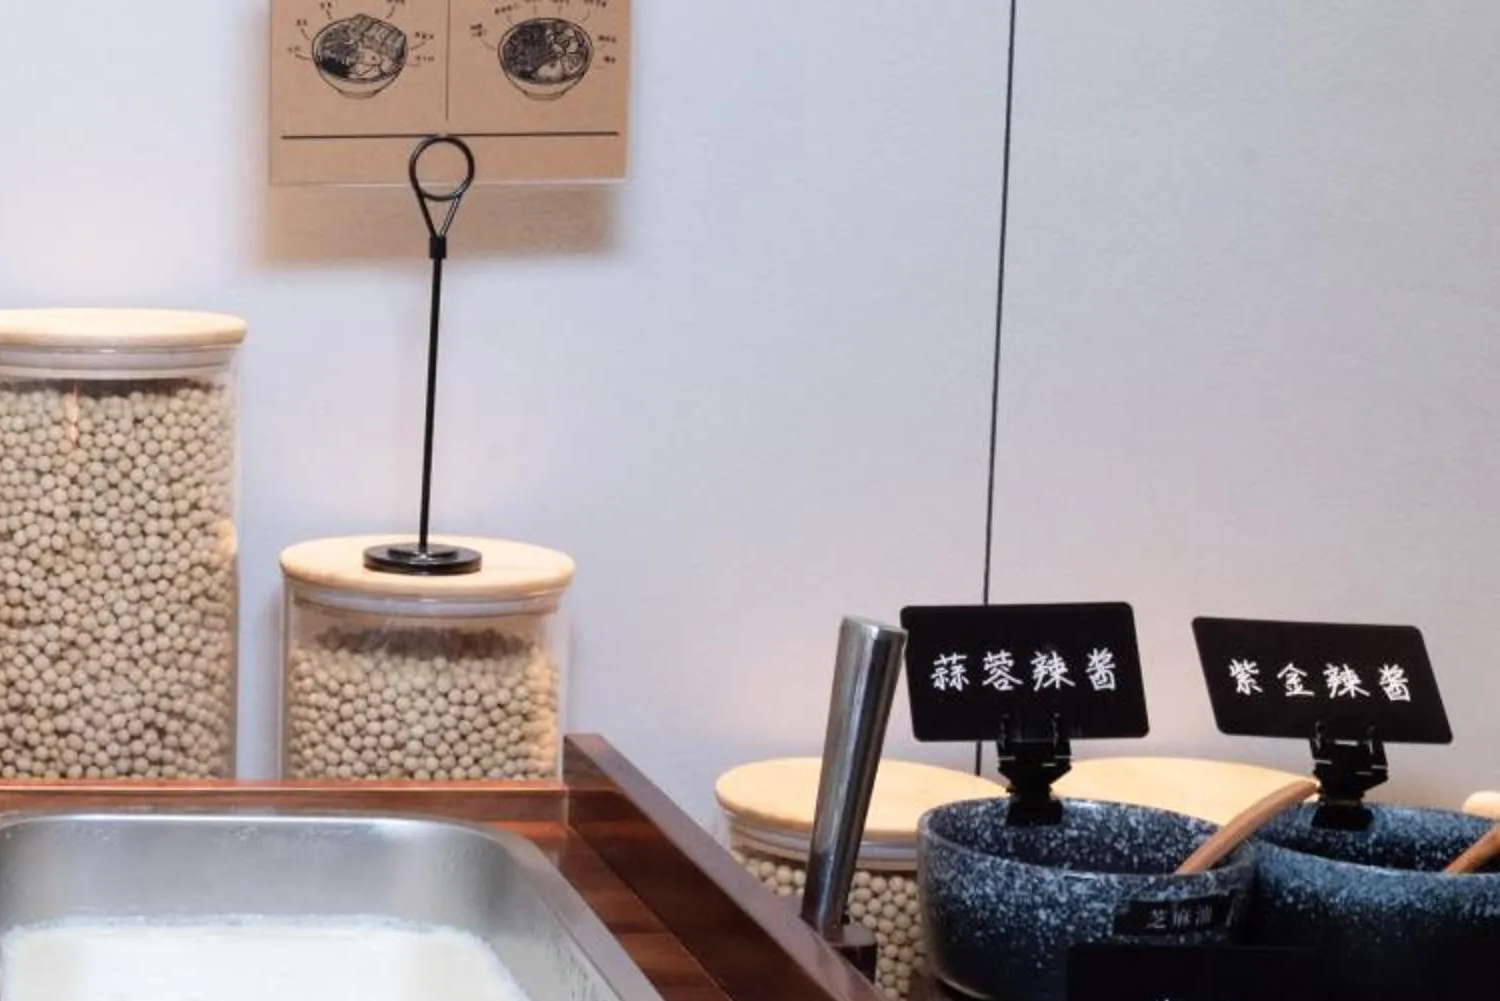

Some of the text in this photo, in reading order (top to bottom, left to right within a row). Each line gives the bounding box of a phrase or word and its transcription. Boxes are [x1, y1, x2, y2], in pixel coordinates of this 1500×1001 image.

[930, 647, 1117, 692] 蒜蓉辣酱
[1228, 658, 1412, 702] 紫金辣酱
